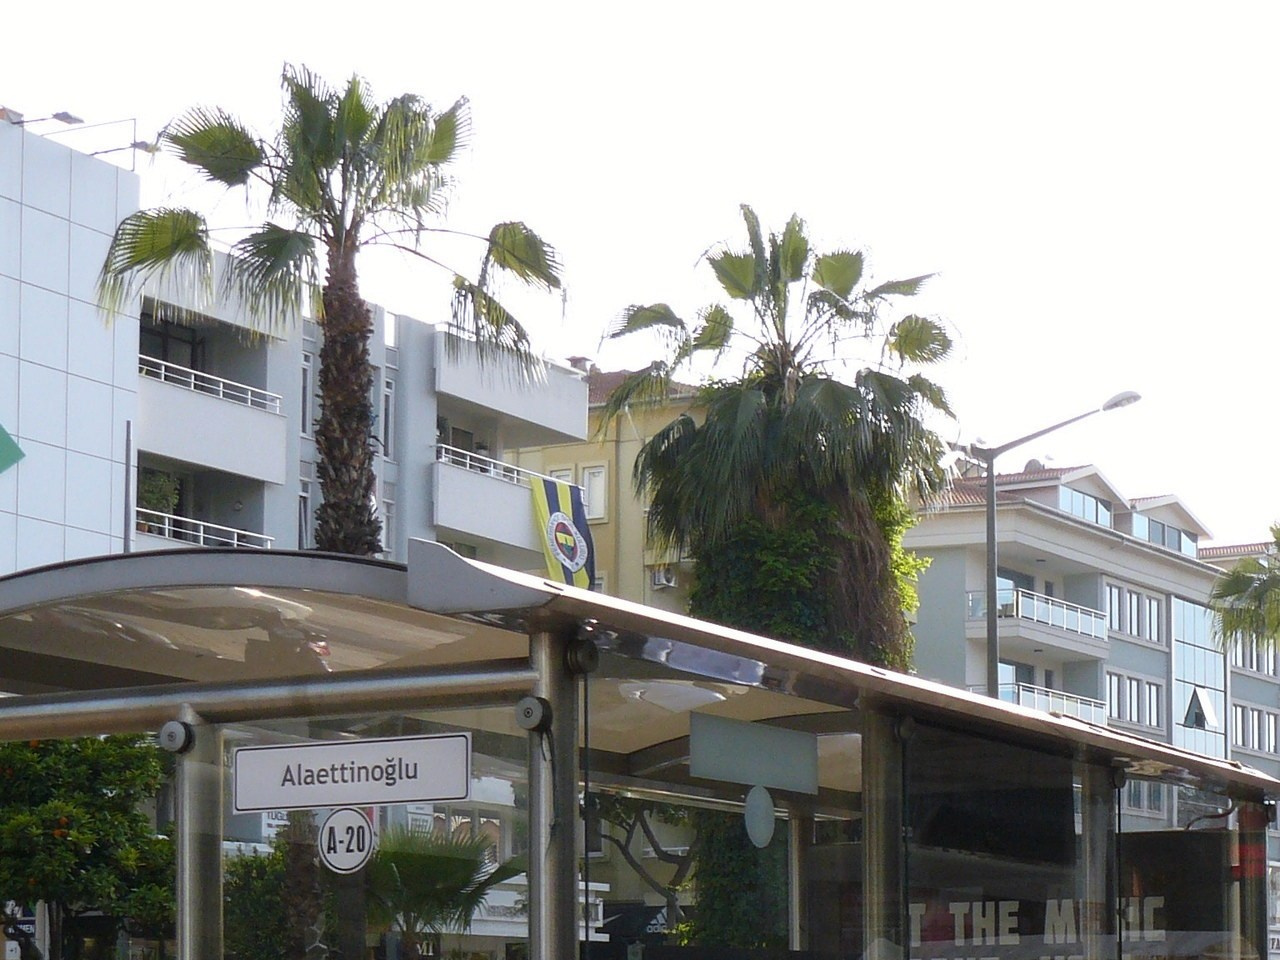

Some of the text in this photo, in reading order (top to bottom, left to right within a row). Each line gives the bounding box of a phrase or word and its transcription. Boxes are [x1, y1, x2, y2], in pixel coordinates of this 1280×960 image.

[281, 757, 419, 787] Alaettinoğlu
[326, 825, 367, 855] A-20
[949, 901, 1020, 947] THE
